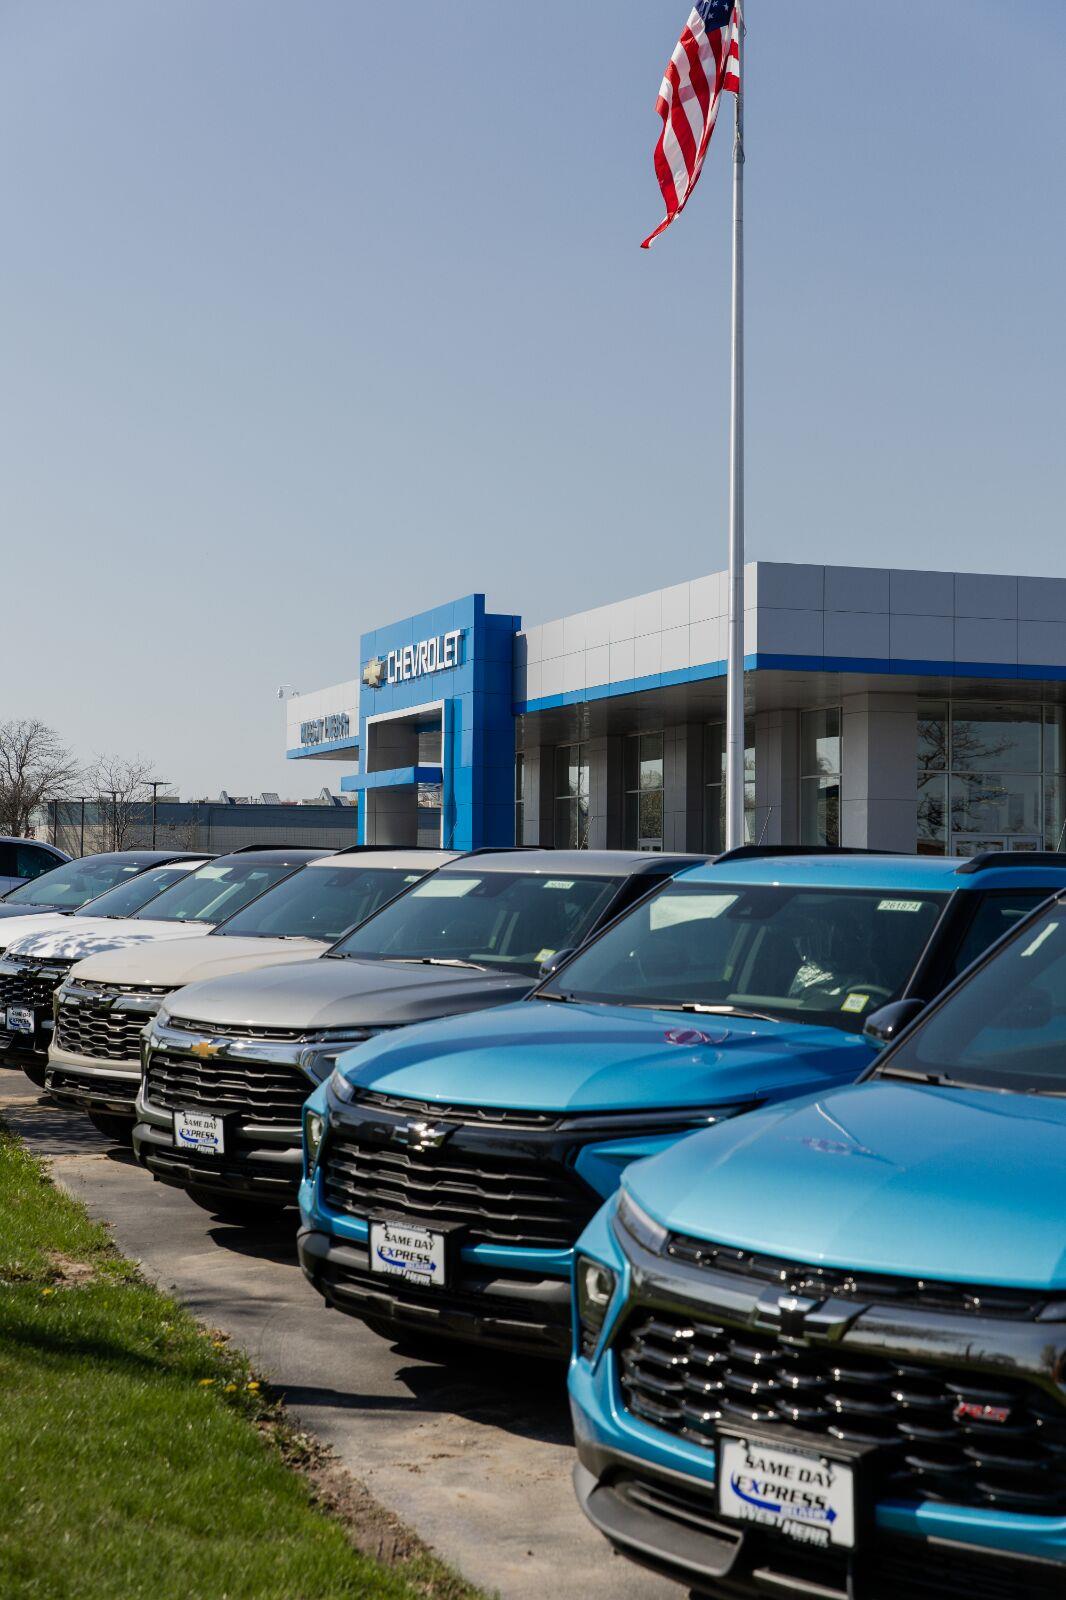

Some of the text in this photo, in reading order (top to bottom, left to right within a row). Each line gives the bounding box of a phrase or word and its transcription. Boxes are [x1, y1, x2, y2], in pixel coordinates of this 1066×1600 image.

[387, 629, 462, 684] CHEVROLET
[181, 1128, 215, 1139] EXPRESS
[204, 1121, 217, 1129] DAY
[384, 1232, 436, 1251] SAME DAY
[380, 1246, 430, 1264] EXPRESS
[744, 1454, 836, 1489] SAME DAY
[736, 1475, 828, 1510] EXPRESS
